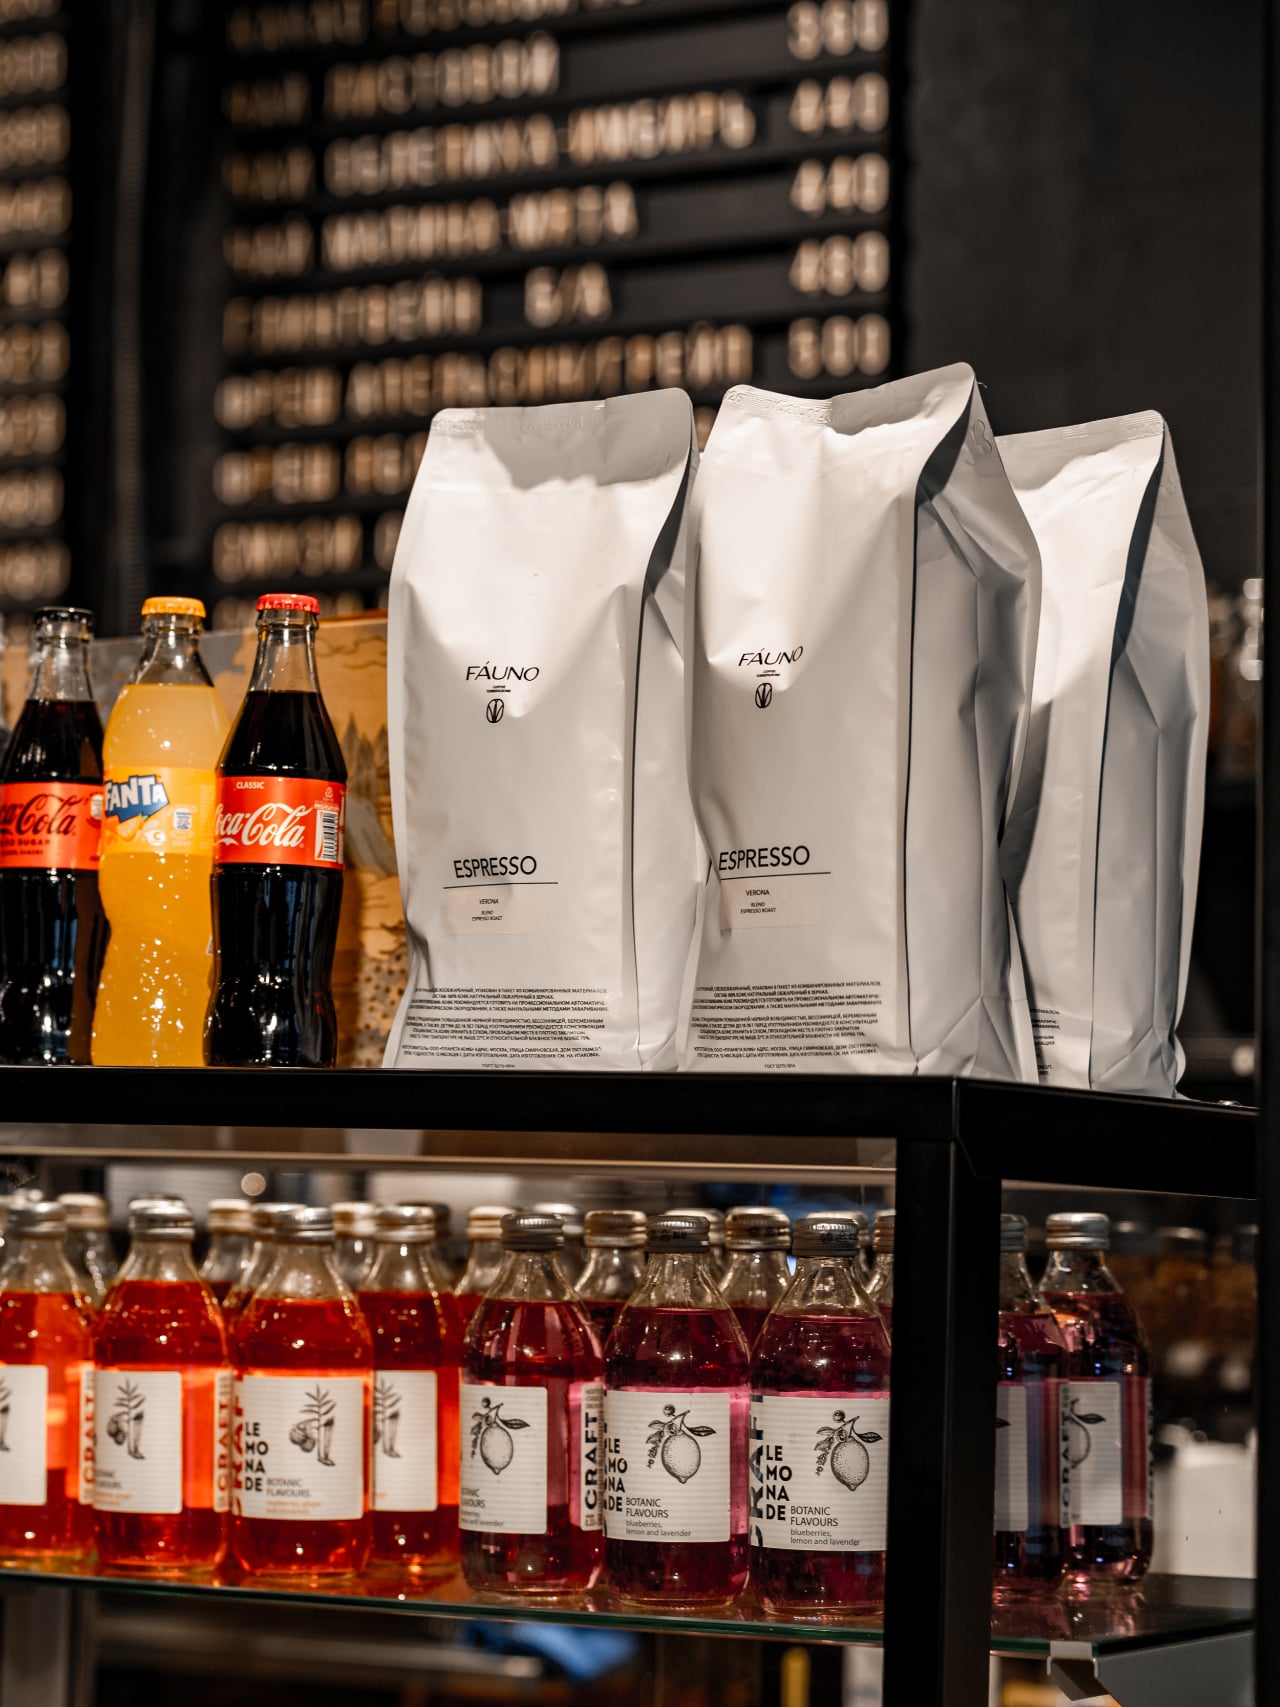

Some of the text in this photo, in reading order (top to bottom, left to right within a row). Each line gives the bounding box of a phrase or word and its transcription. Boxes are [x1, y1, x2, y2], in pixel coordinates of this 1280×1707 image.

[738, 646, 804, 666] FÁUNO
[466, 661, 540, 681] FÁUNO
[105, 777, 166, 811] FANTA
[719, 846, 810, 871] ESPRESSO
[454, 856, 537, 878] ESPRESSO
[245, 1422, 260, 1436] LE
[245, 1441, 269, 1455] MO
[609, 1438, 620, 1454] LE
[766, 1445, 783, 1461] LE
[245, 1459, 266, 1473] NA
[585, 1412, 598, 1509] CRAFT
[609, 1458, 628, 1474] MO
[766, 1465, 792, 1481] MO
[245, 1477, 263, 1491] DE
[609, 1477, 625, 1493] NA
[766, 1485, 790, 1501] NA
[609, 1496, 623, 1512] DE
[626, 1497, 661, 1507] BOTANIC
[626, 1508, 669, 1518] FLAVOURS
[766, 1504, 786, 1520] DE
[790, 1506, 830, 1516] BOTANIC
[790, 1517, 838, 1527] FLAVOURS
[626, 1528, 691, 1537] lemon and lavender
[791, 1529, 832, 1538] blueberries,
[790, 1537, 860, 1546] lemon and lavender
